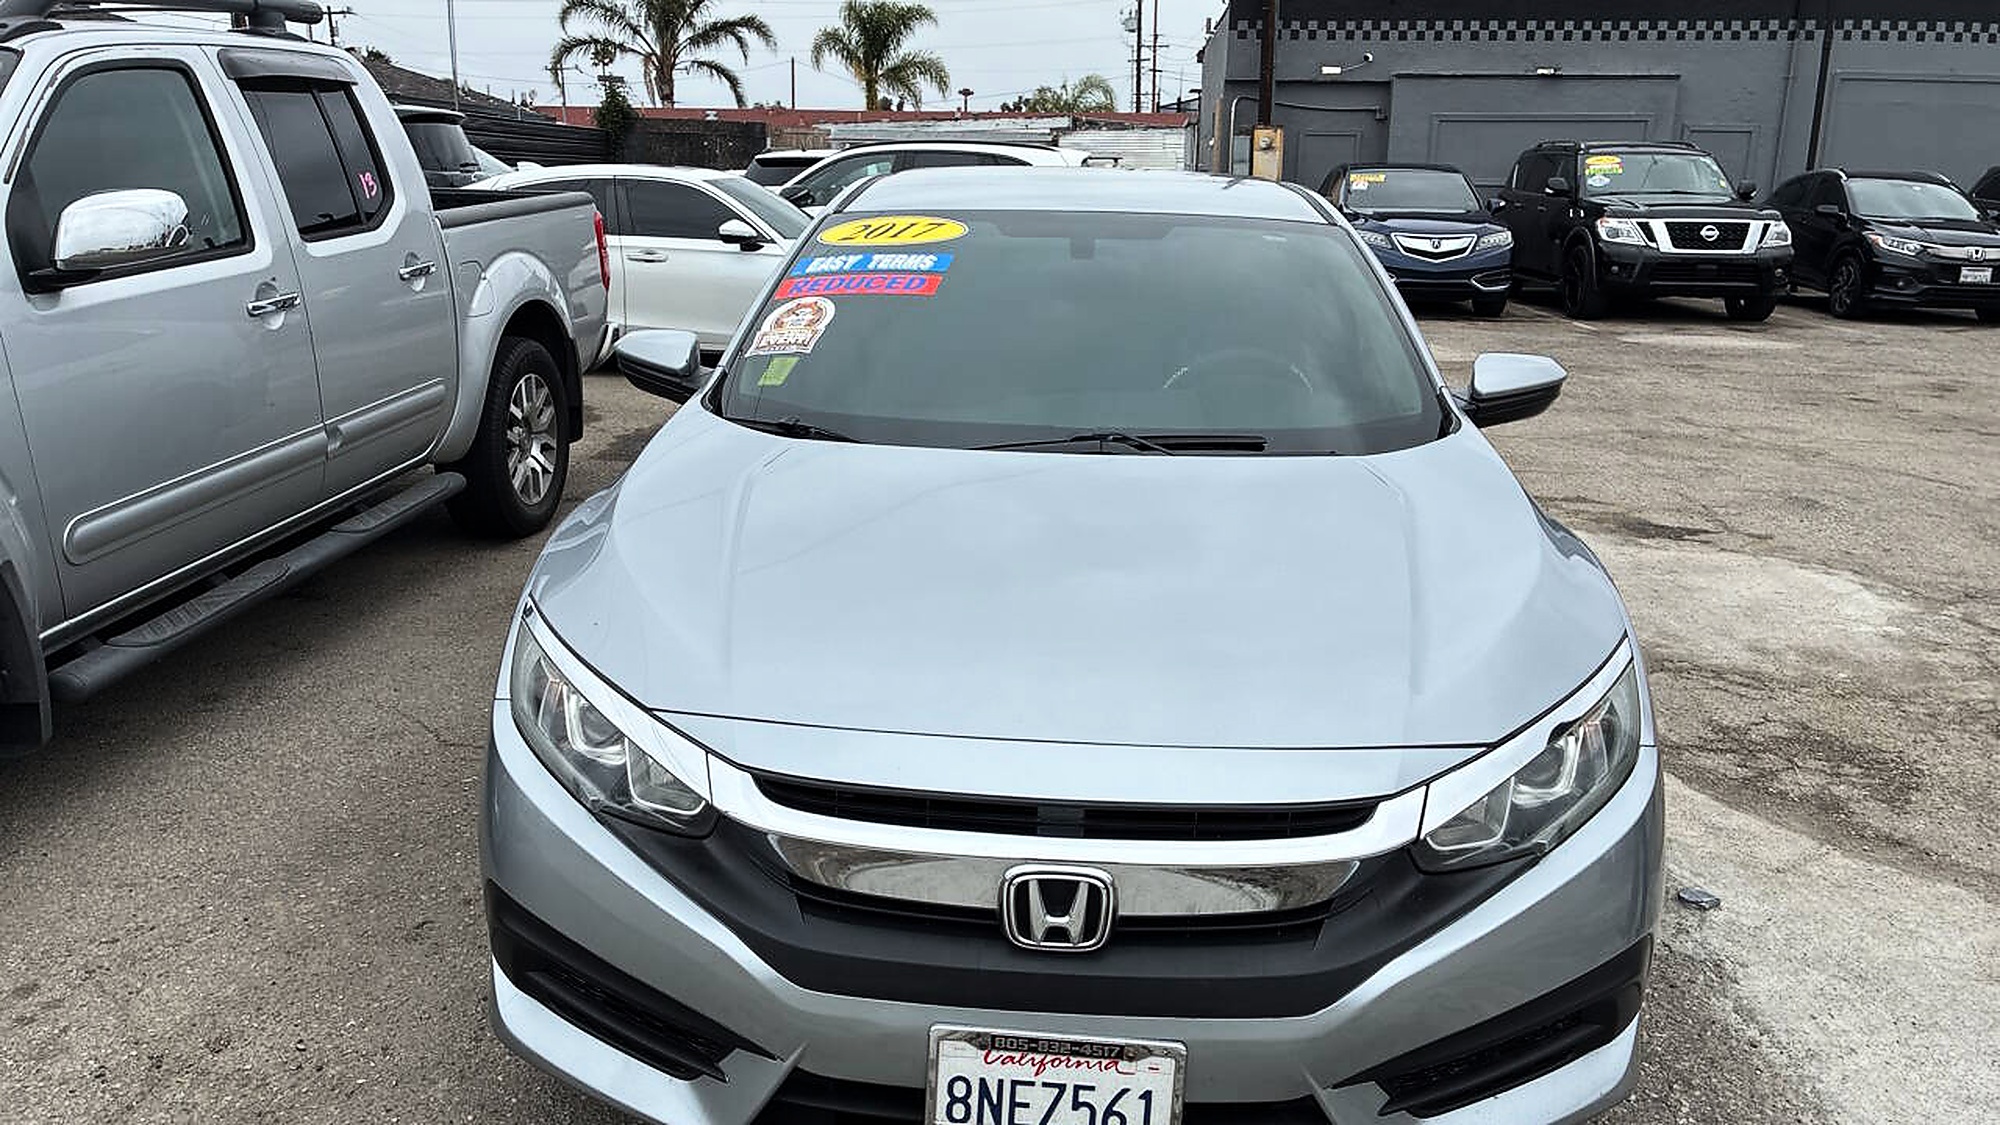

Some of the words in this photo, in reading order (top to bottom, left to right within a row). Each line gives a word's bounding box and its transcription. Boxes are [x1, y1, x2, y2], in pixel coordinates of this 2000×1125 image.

[358, 172, 377, 199] 13
[837, 222, 947, 242] 2017
[805, 255, 863, 274] EASY
[867, 253, 938, 271] TERMS
[789, 275, 925, 294] REDUCED
[993, 1036, 1121, 1058] 805-832-4517
